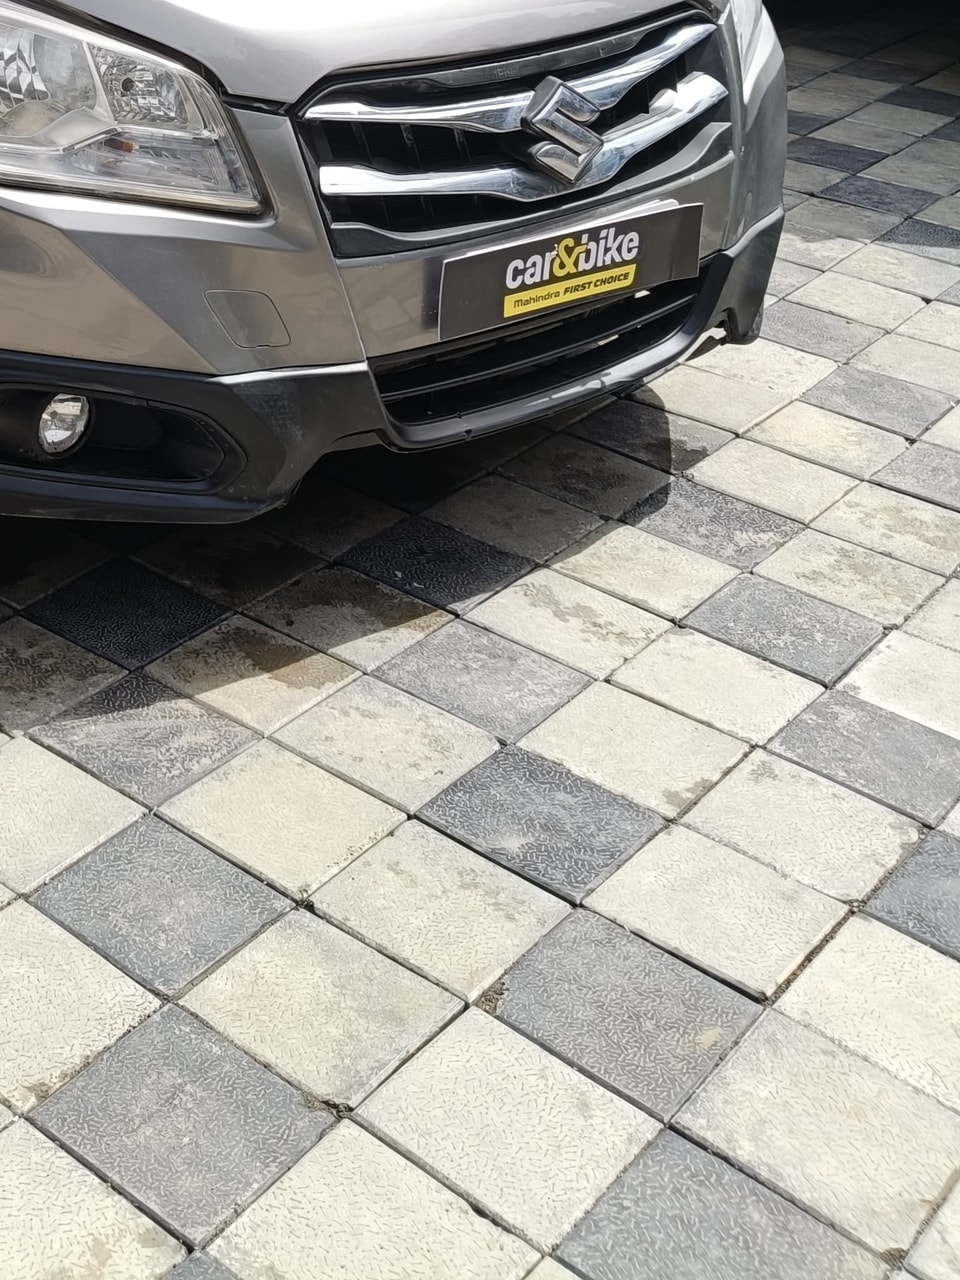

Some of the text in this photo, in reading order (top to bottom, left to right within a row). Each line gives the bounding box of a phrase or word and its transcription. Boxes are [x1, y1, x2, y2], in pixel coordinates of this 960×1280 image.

[505, 227, 639, 289] car&bike
[513, 272, 630, 308] Mahindra FIRST CHOICE
